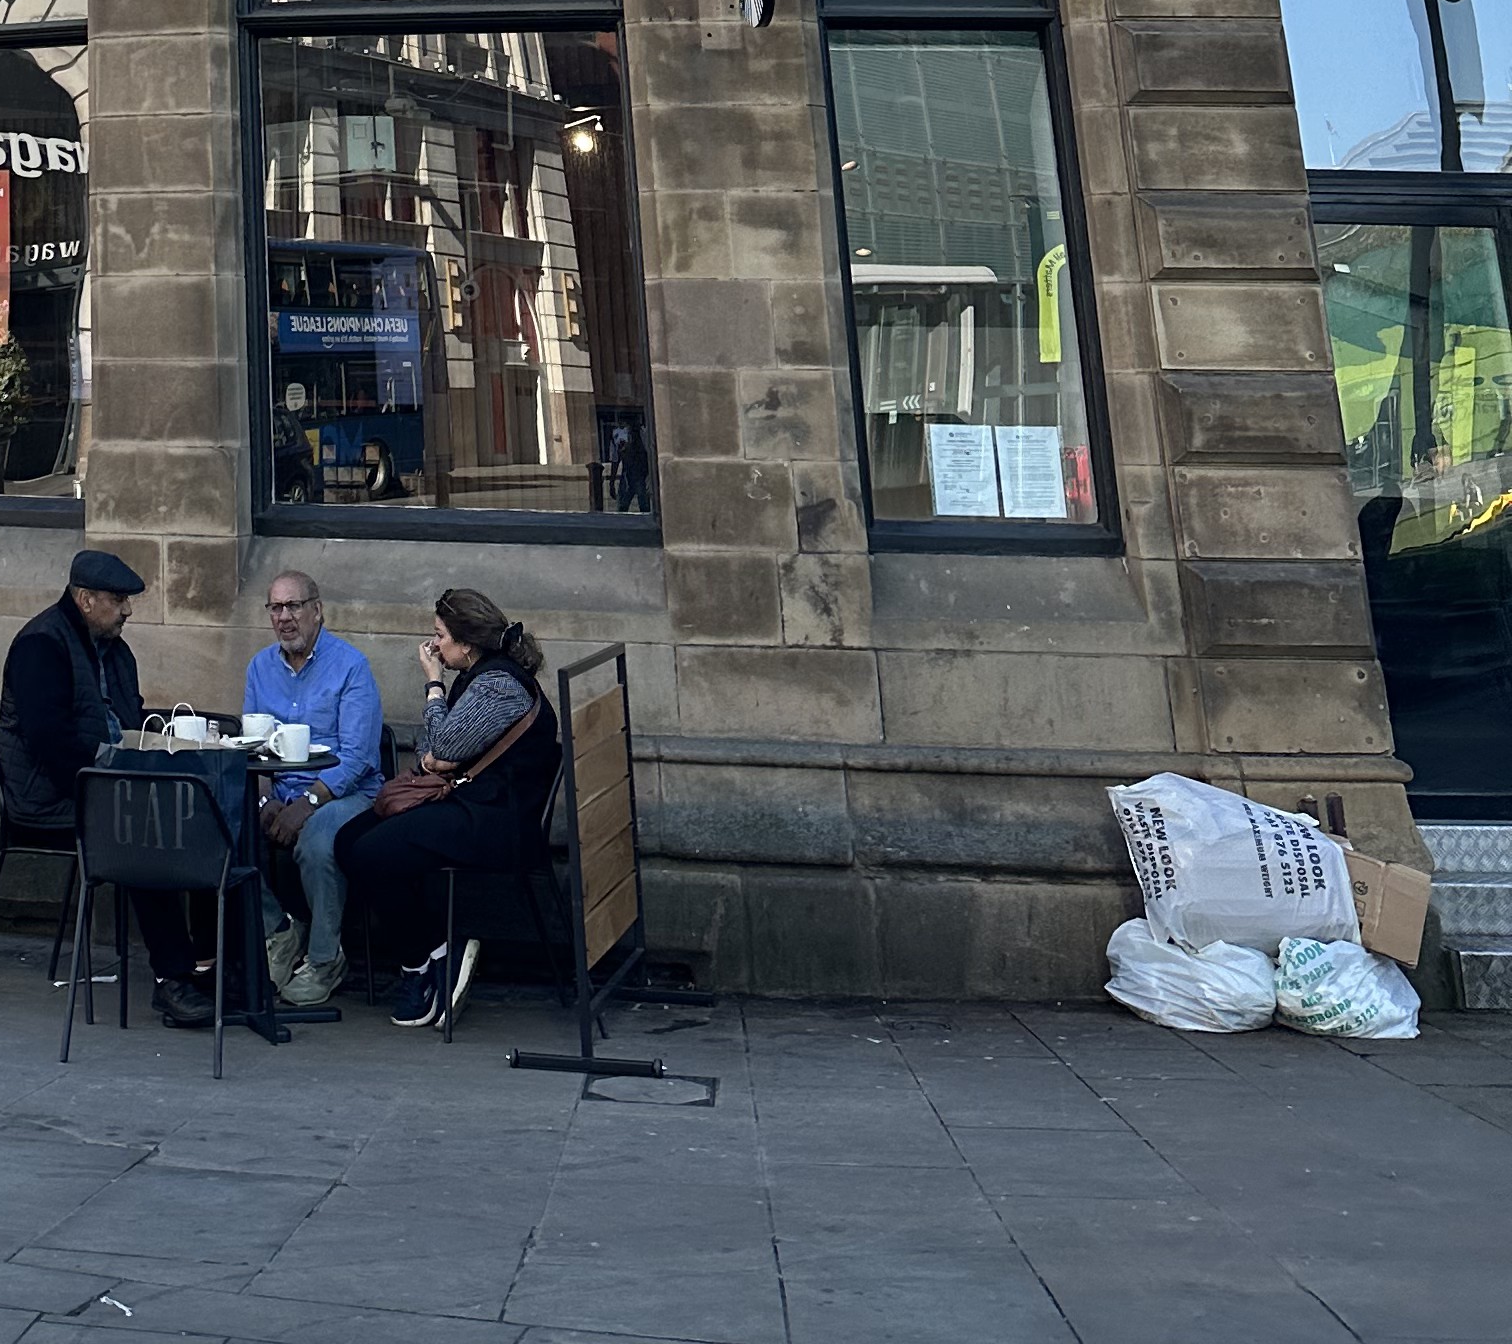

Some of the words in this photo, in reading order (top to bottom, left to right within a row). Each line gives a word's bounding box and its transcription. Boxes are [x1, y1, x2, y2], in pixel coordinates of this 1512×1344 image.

[114, 779, 196, 850] GAP
[1150, 807, 1168, 841] NEW
[1274, 833, 1288, 857] 876
[1146, 843, 1163, 901] DISPOSAL
[1158, 846, 1177, 891] LOOK
[1280, 862, 1295, 895] 5123
[1290, 839, 1311, 899] DISPOSAL
[1306, 845, 1327, 890] LOOK
[1291, 942, 1326, 970] LOOK
[1301, 961, 1334, 985] PAPER
[1301, 992, 1323, 1009] AND
[1354, 1003, 1379, 1028] 5123
